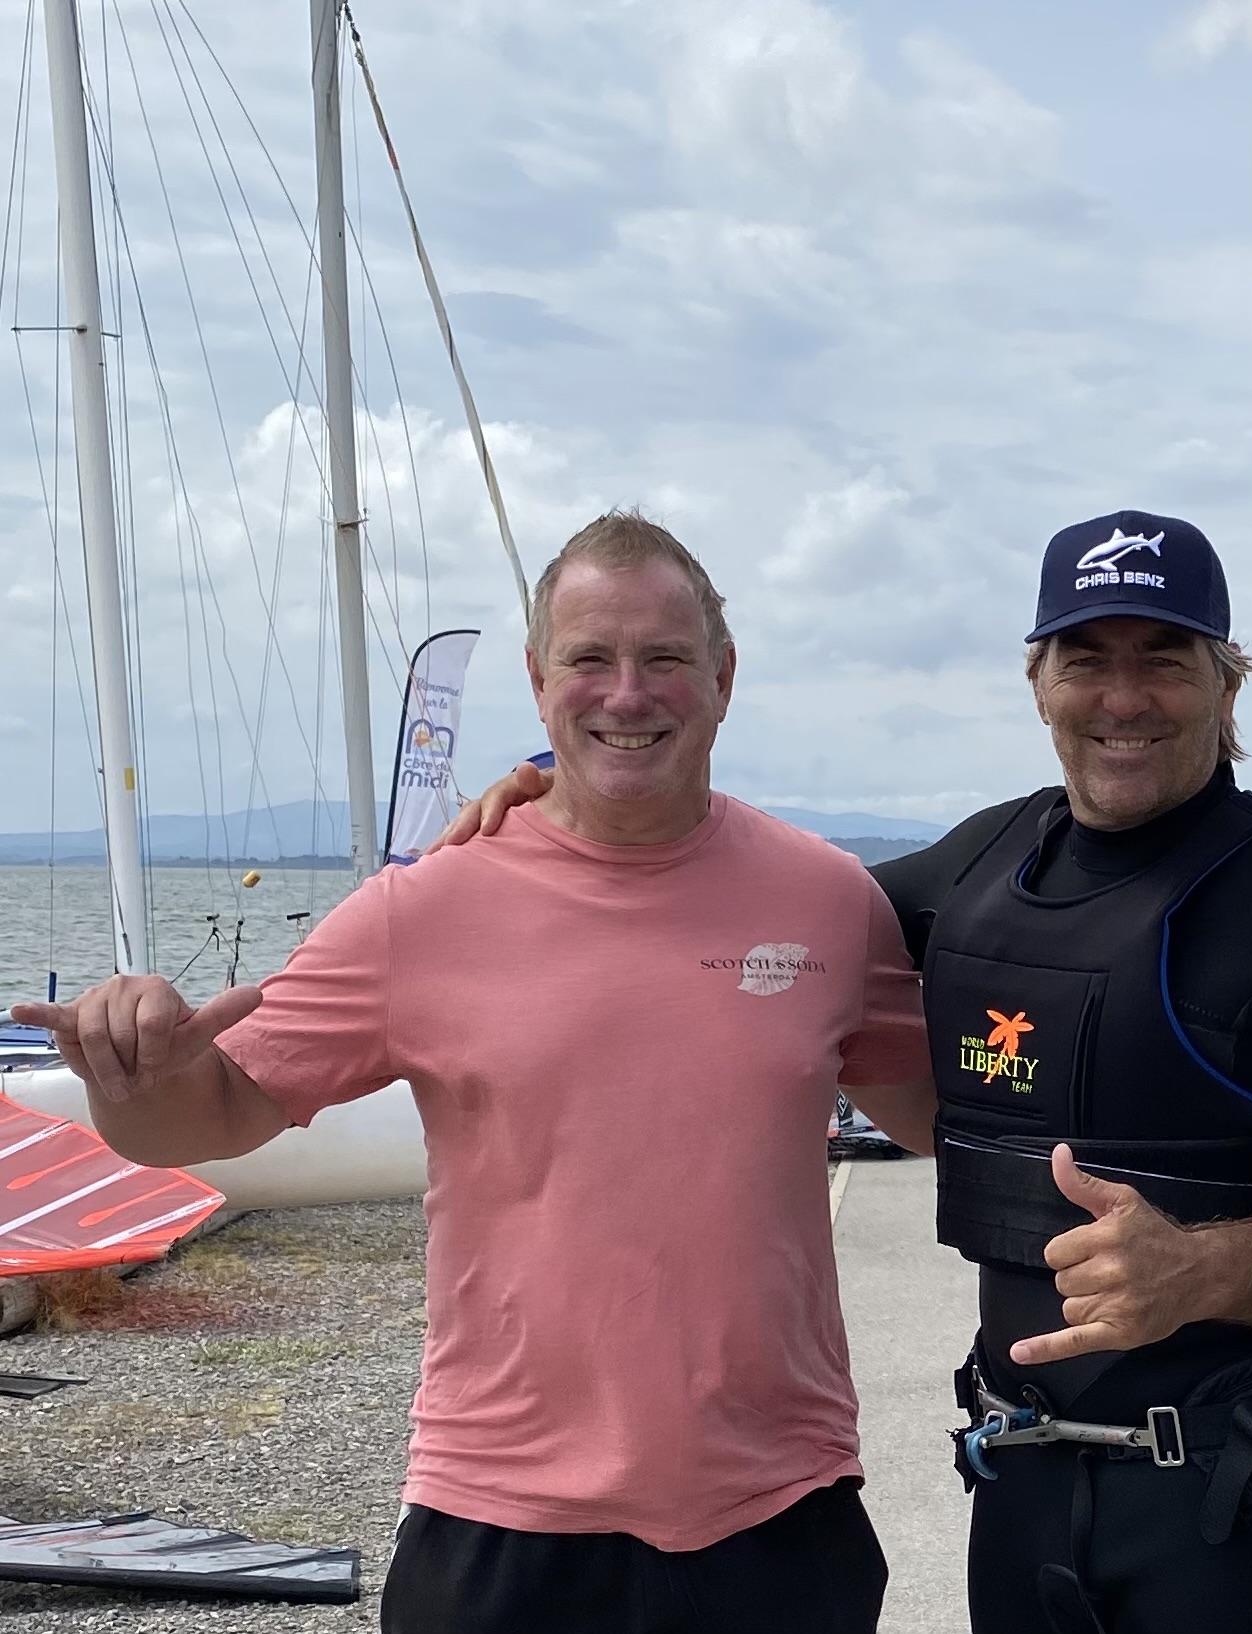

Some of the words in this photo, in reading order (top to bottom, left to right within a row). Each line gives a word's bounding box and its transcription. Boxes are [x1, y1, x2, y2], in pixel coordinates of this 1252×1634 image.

[1075, 571, 1120, 590] CHRIS
[1123, 571, 1165, 589] BENZ
[401, 769, 449, 789] midi
[700, 958, 769, 971] SCOTCH
[787, 958, 827, 974] SODA
[741, 973, 798, 981] AMSTERDAM
[961, 1035, 985, 1050] WORLD
[960, 1047, 1039, 1080] LIBERTY
[1011, 1080, 1034, 1094] TEAM
